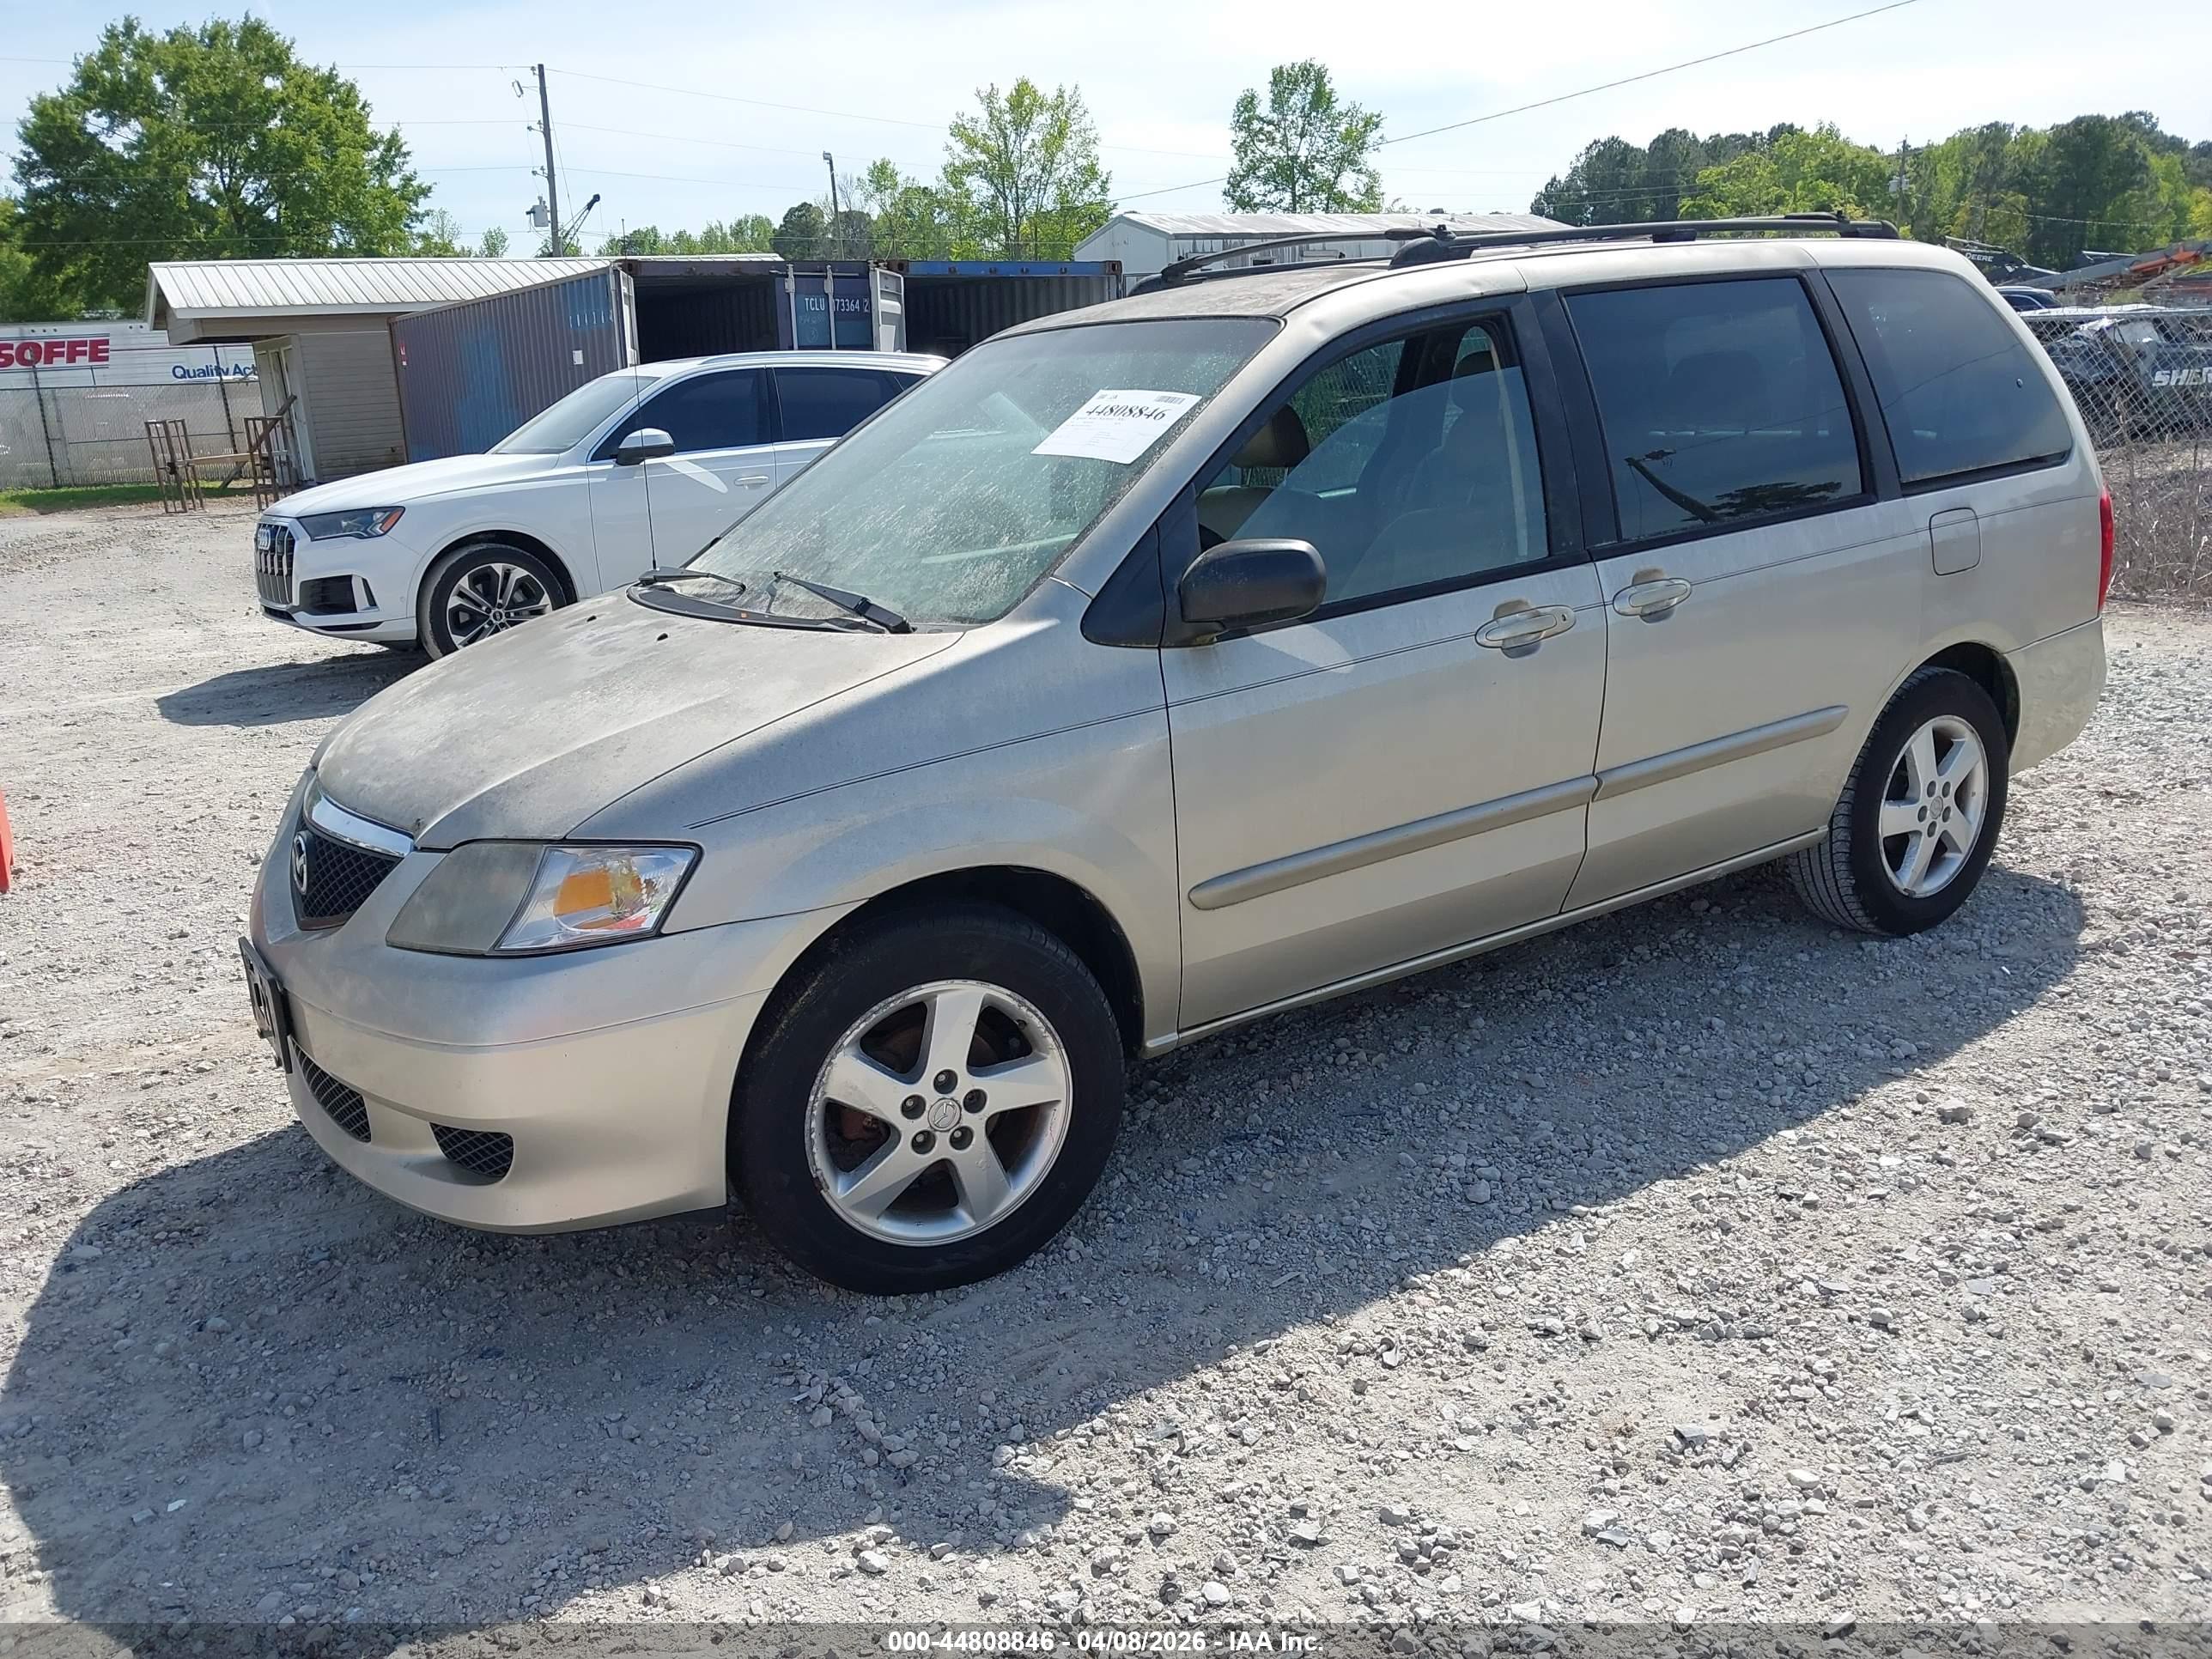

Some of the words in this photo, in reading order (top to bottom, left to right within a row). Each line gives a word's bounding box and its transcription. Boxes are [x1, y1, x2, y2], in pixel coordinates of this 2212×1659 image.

[1966, 252, 1994, 262] DEERE
[805, 297, 825, 311] TCLU
[0, 338, 110, 368] SOFFE
[1085, 404, 1173, 421] 44808846
